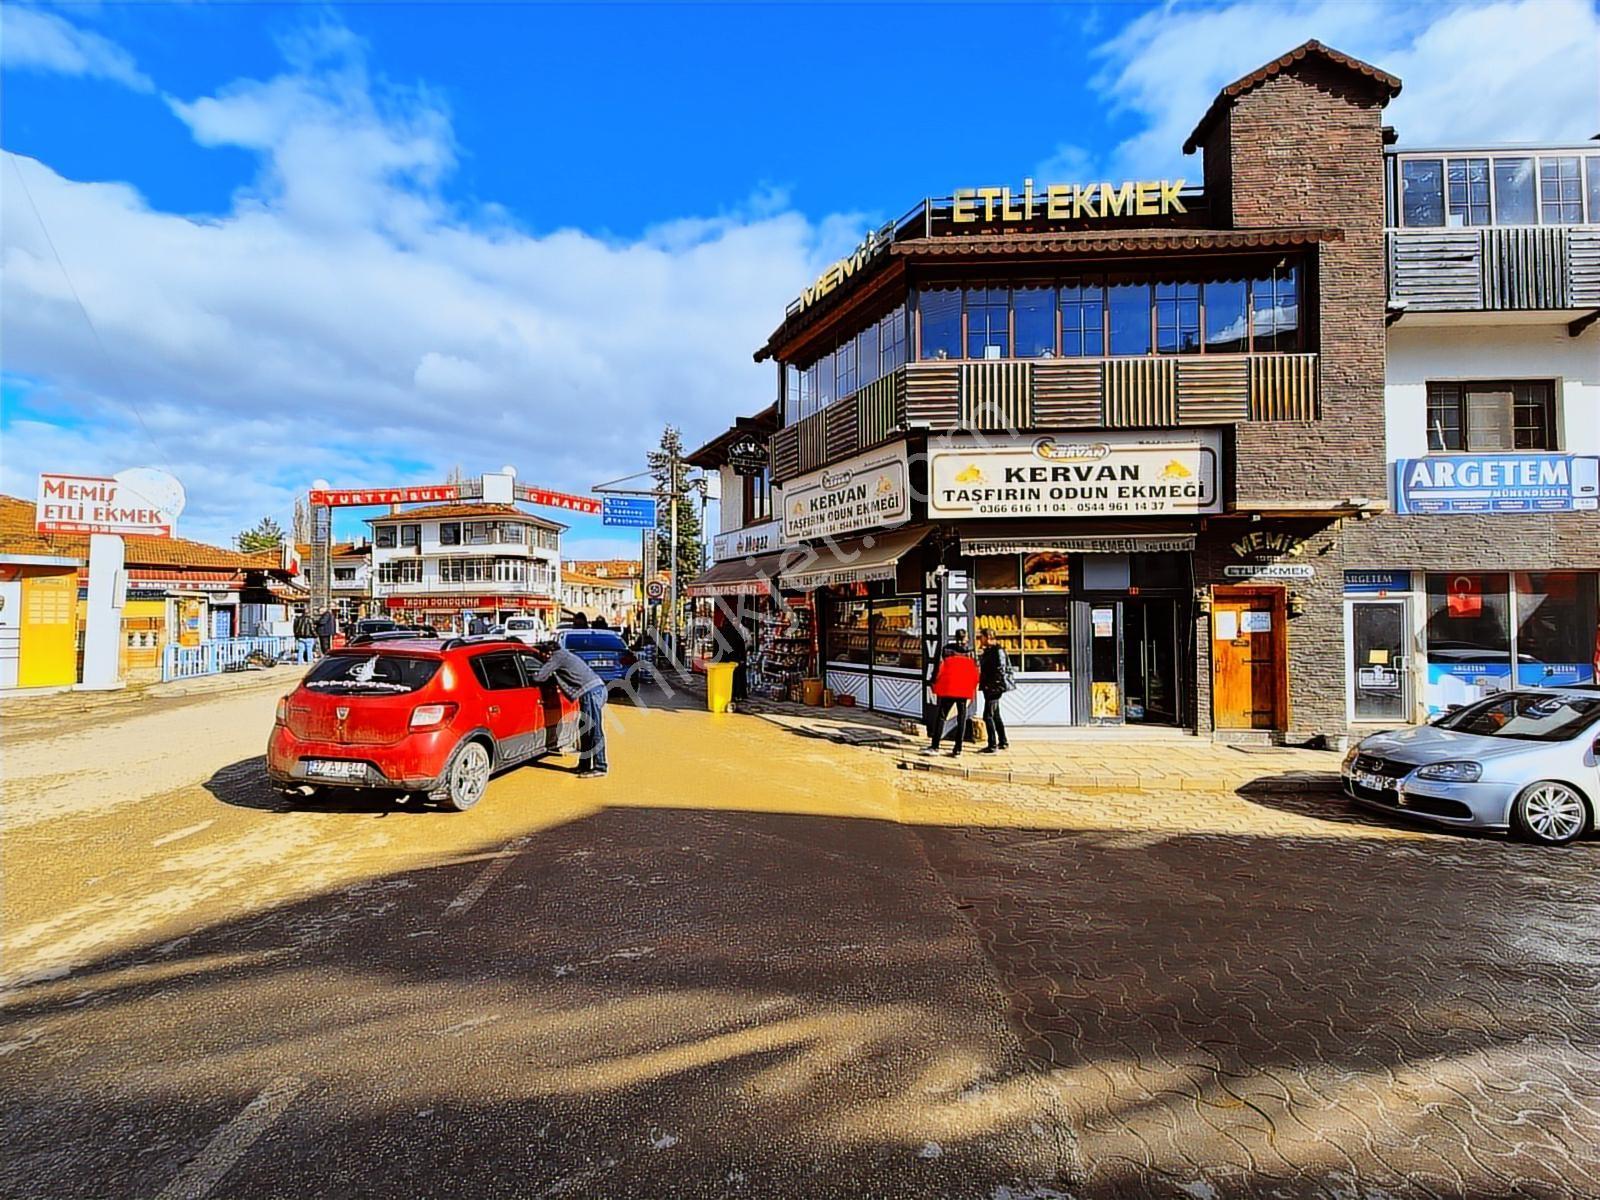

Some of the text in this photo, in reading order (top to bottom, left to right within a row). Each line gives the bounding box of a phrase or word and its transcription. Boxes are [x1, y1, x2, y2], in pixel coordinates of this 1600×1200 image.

[953, 178, 1188, 223] ETLİ EKMEK
[1005, 465, 1140, 483] KERVAN
[1408, 460, 1569, 488] ARGETEM
[327, 493, 399, 505] YURTTA
[809, 484, 867, 512] KERVAN
[943, 481, 1205, 505] TAŞFIRIN ODUN EKMEĞİ
[44, 503, 162, 524] ETLİ EKMEK
[828, 505, 853, 522] ODUN
[856, 492, 899, 515] EKMEĞİ
[980, 503, 1008, 513] 0366
[1011, 503, 1032, 513] 616
[1052, 502, 1066, 512] 04
[1076, 502, 1105, 512] 0544
[1108, 502, 1129, 512] 961
[1134, 502, 1148, 512] 14
[1150, 501, 1165, 511] 37
